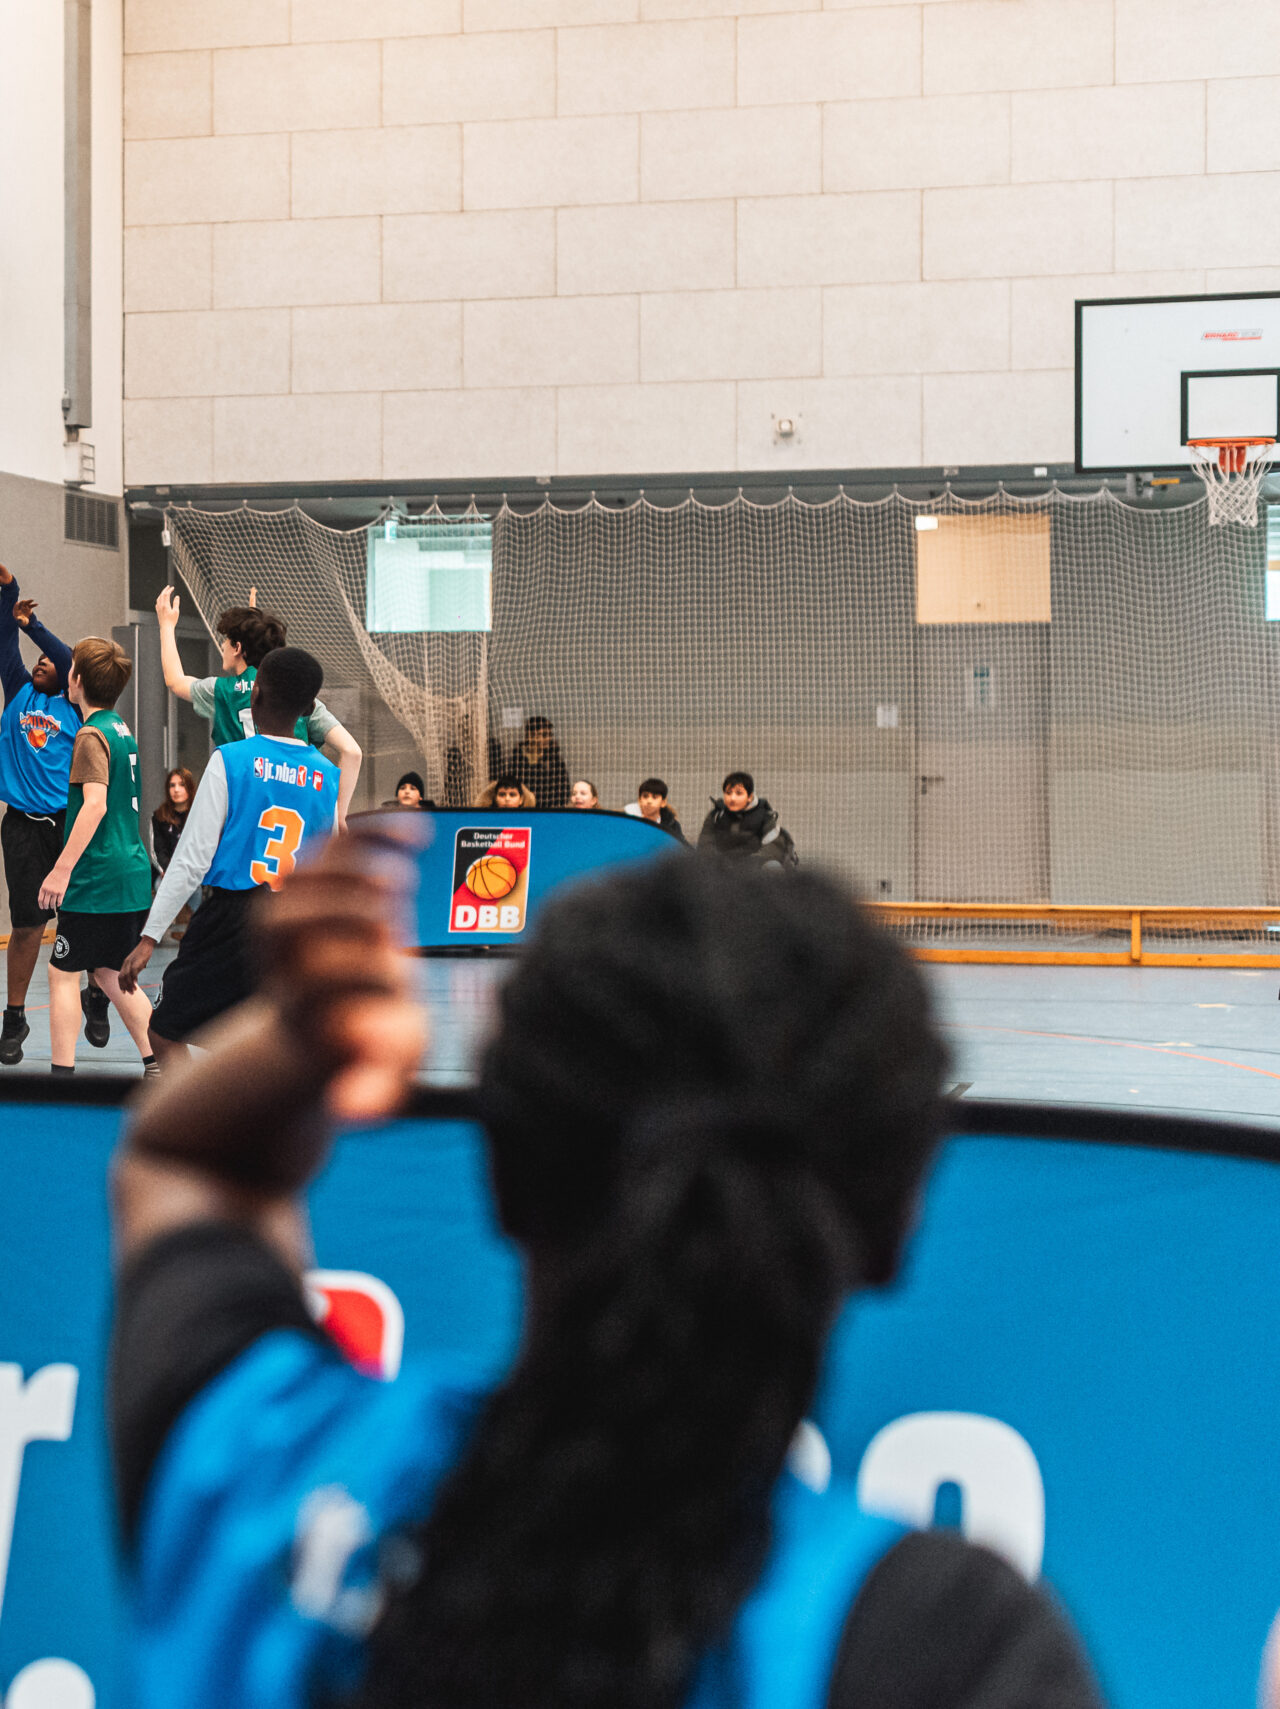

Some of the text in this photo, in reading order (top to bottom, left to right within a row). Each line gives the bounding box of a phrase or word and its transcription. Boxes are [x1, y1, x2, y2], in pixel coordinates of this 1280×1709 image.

[473, 832, 513, 840] Deutscher
[249, 804, 305, 892] 3
[461, 840, 526, 848] Basketball Bund
[454, 905, 520, 928] DBB
